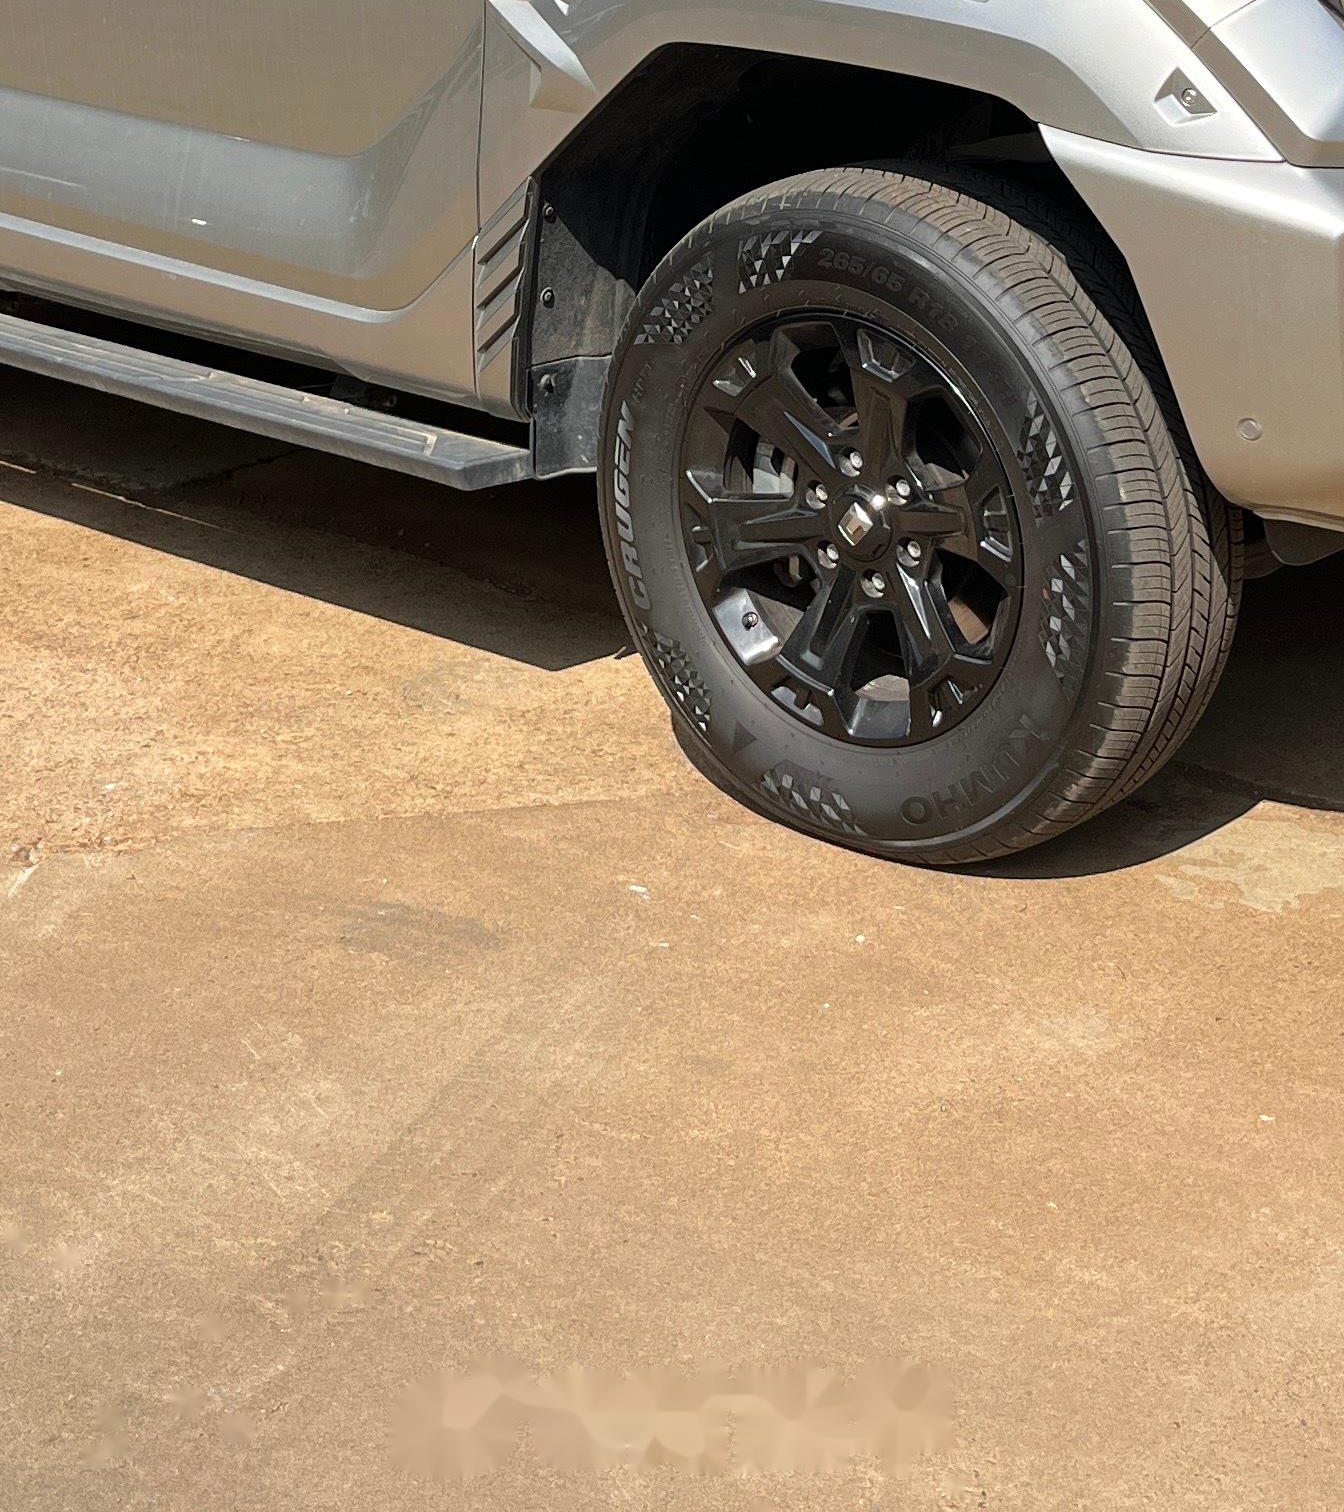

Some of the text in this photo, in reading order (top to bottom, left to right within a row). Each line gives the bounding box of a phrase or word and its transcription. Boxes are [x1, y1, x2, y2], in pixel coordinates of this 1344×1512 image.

[817, 247, 906, 292] 265/65
[613, 399, 652, 610] CRUGEN
[901, 713, 1042, 824] KUMHO
